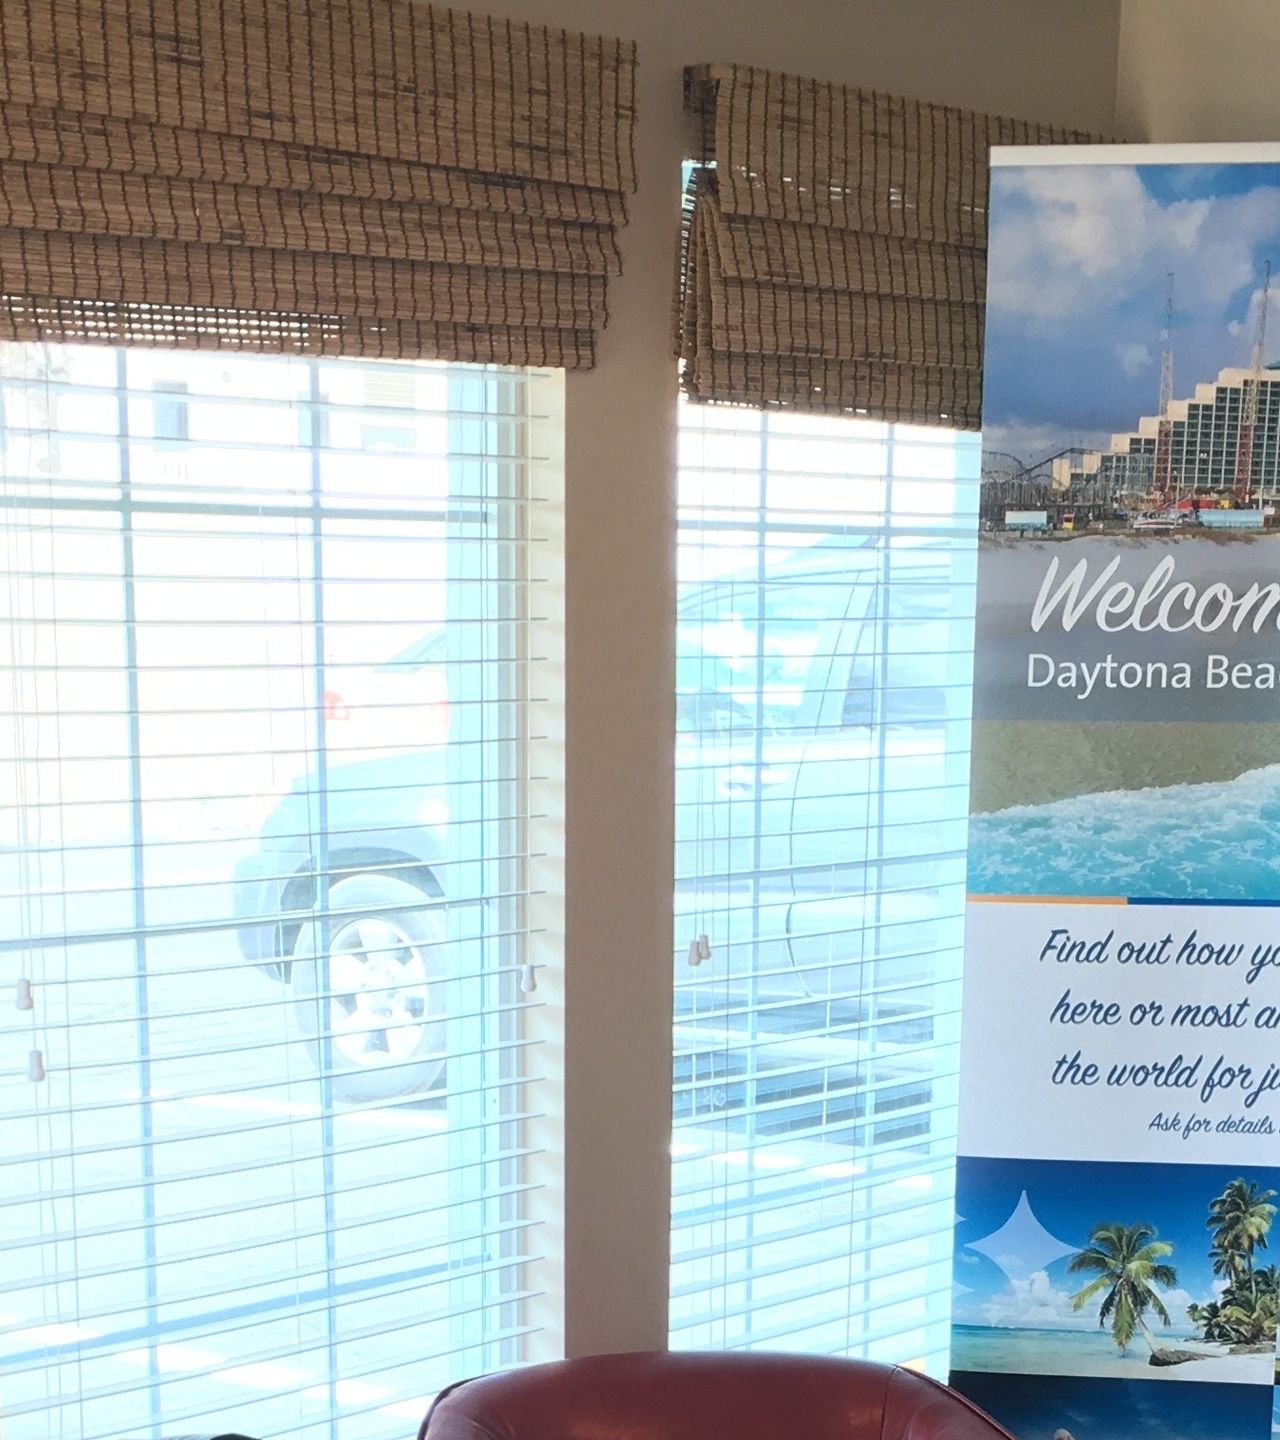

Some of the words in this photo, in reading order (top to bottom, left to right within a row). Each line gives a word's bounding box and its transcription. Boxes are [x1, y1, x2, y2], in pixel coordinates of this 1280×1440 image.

[1027, 653, 1192, 699] Daytona
[1039, 929, 1115, 963] Find
[1117, 933, 1173, 965] out
[1175, 929, 1244, 966] how
[1049, 988, 1122, 1024] here
[1129, 1000, 1164, 1025] or
[1170, 997, 1250, 1027] most
[1051, 1050, 1100, 1085] the
[1107, 1054, 1203, 1088] world
[1200, 1055, 1253, 1103] for
[1148, 1112, 1181, 1131] Ask
[1182, 1113, 1211, 1140] for
[1216, 1114, 1275, 1135] details
